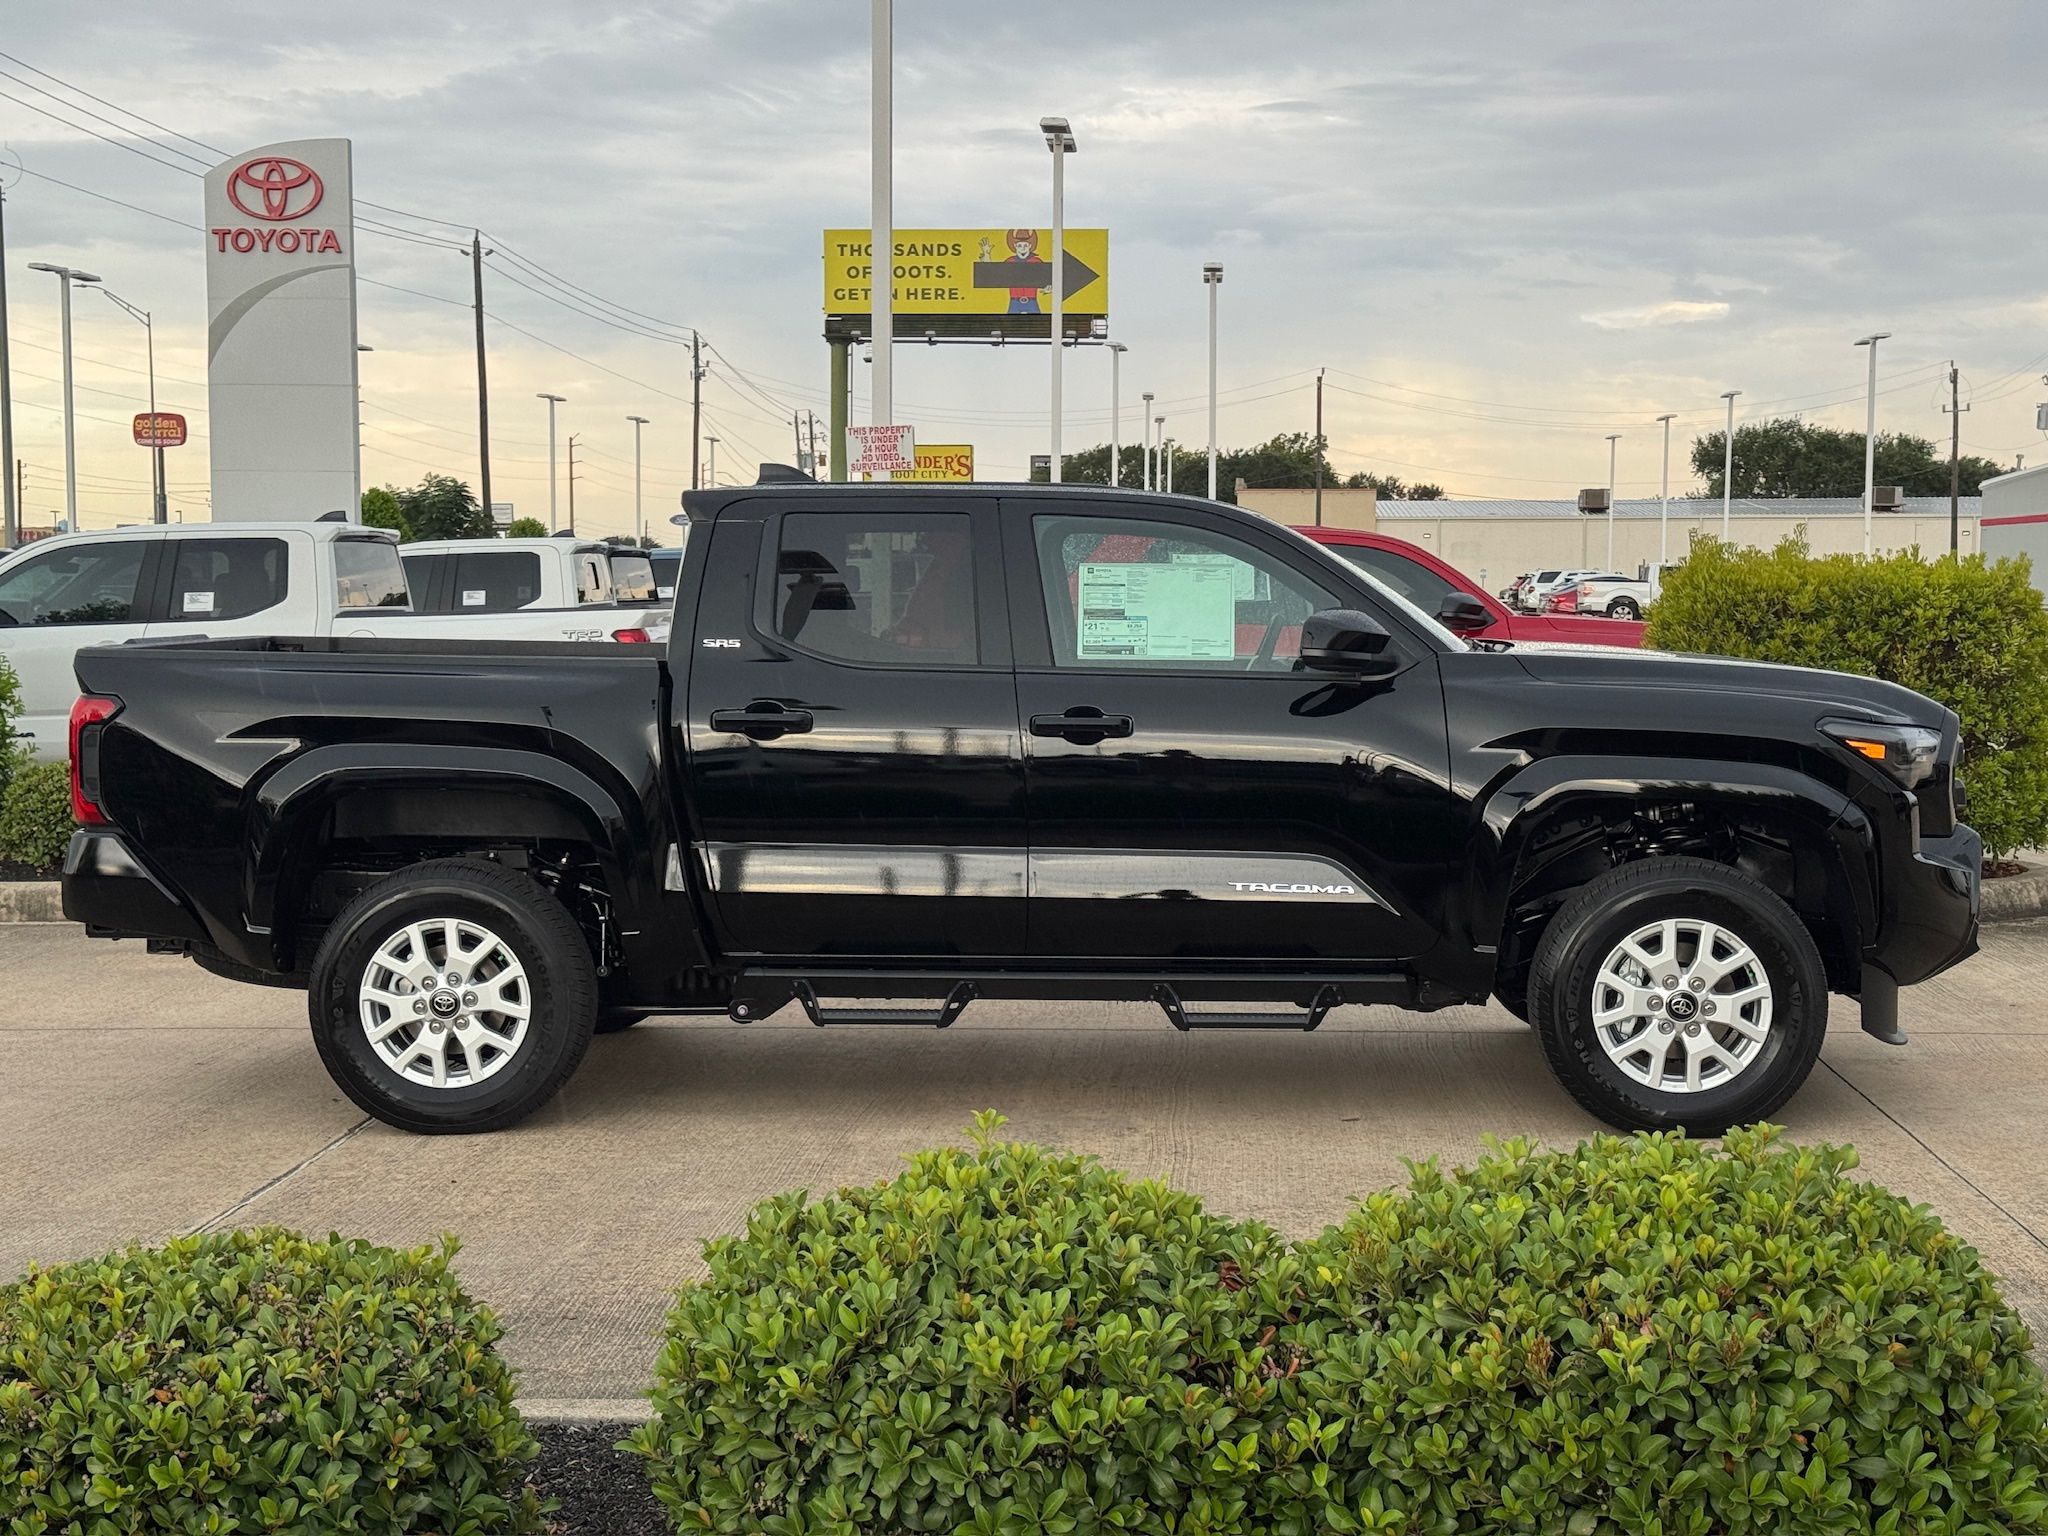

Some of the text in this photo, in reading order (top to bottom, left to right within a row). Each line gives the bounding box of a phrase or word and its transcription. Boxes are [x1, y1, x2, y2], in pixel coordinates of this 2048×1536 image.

[211, 227, 342, 253] TOYOTA
[837, 243, 962, 256] THOSANDS
[846, 265, 952, 279] OF OOTS.
[833, 288, 872, 301] GET
[906, 288, 965, 300] HERE.
[848, 425, 912, 435] THIS PROPERTY
[872, 435, 899, 443] UNDER
[863, 444, 898, 453] 24 HOUR
[875, 453, 900, 461] VIDEO
[851, 461, 912, 471] SURVEILLANCE
[914, 453, 972, 477] NDER'S
[921, 470, 948, 478] CITY
[562, 629, 603, 640] TRD
[702, 639, 741, 648] SR5
[1228, 881, 1355, 894] TACOMA
